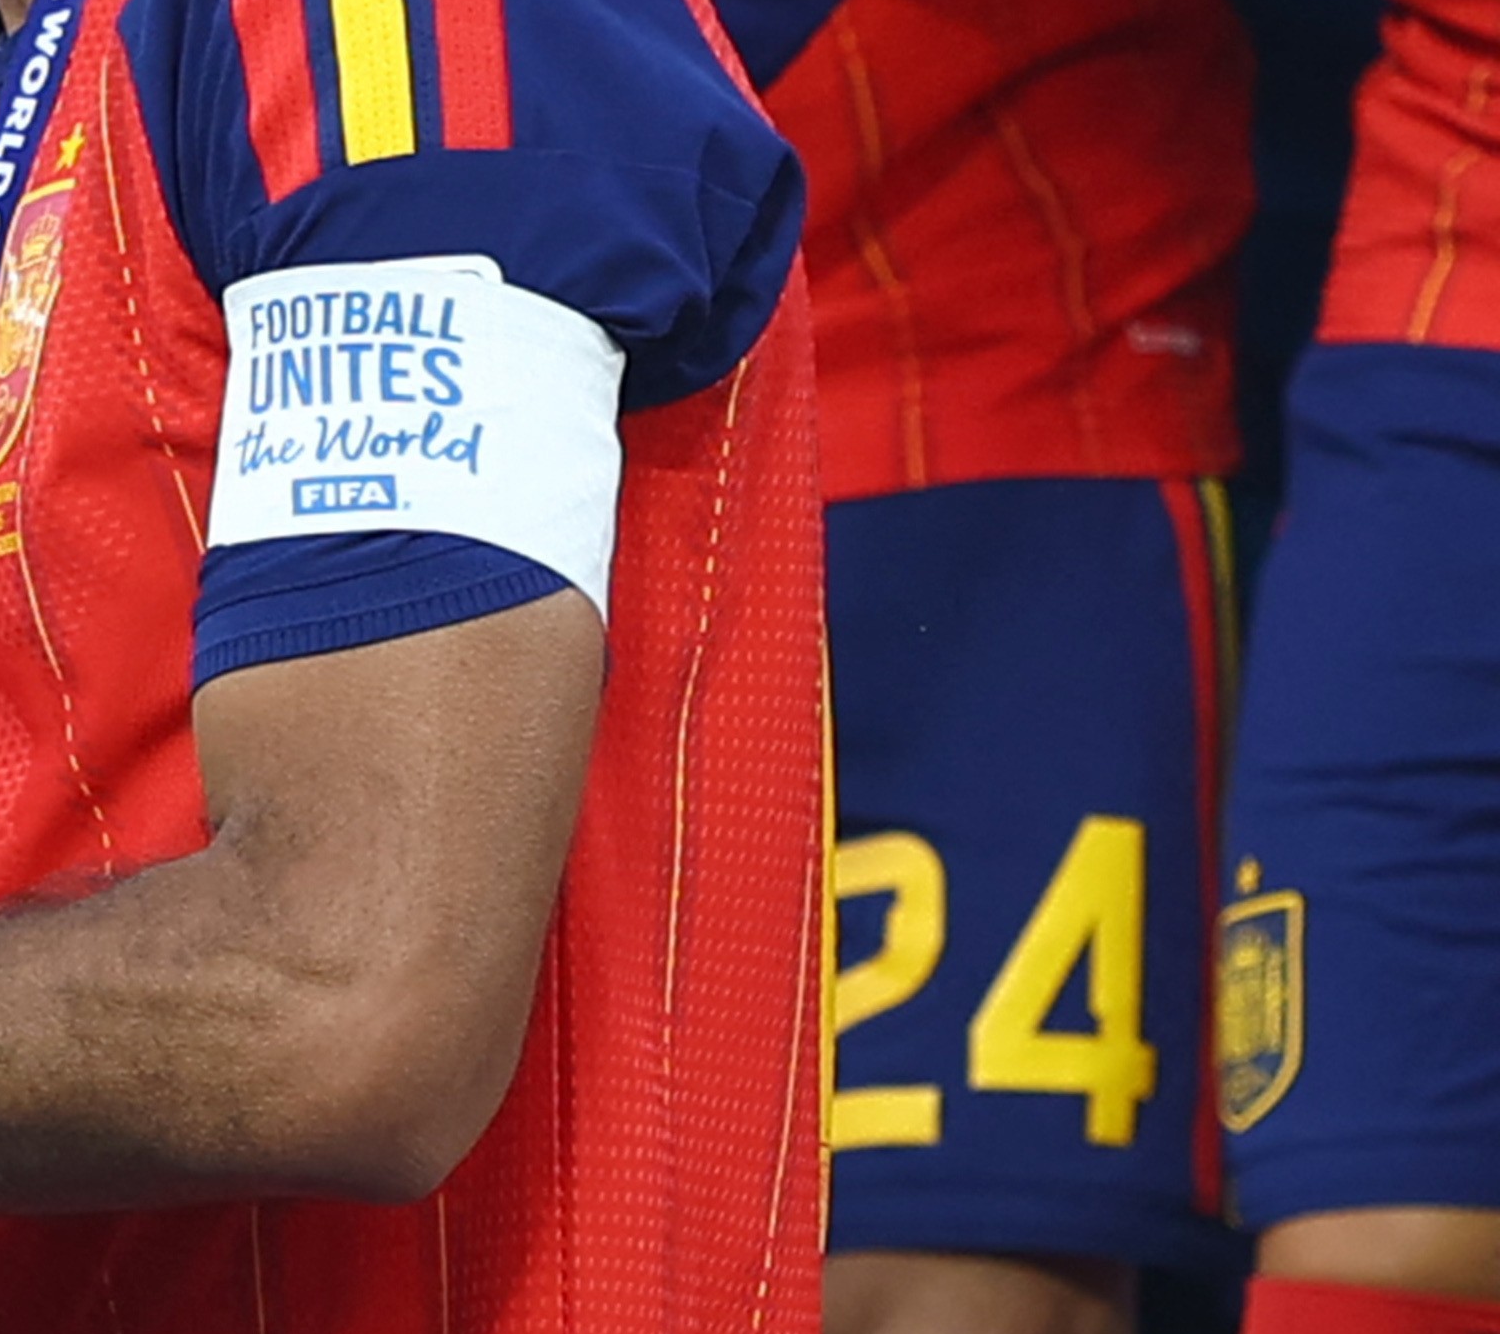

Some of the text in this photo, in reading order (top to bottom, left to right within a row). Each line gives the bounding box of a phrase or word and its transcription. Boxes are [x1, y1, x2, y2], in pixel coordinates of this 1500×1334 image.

[250, 290, 465, 350] FOOTBALL
[249, 342, 463, 414] UNITES
[234, 410, 485, 477] the World
[299, 480, 392, 510] FIFA
[835, 814, 1158, 1149] 24
